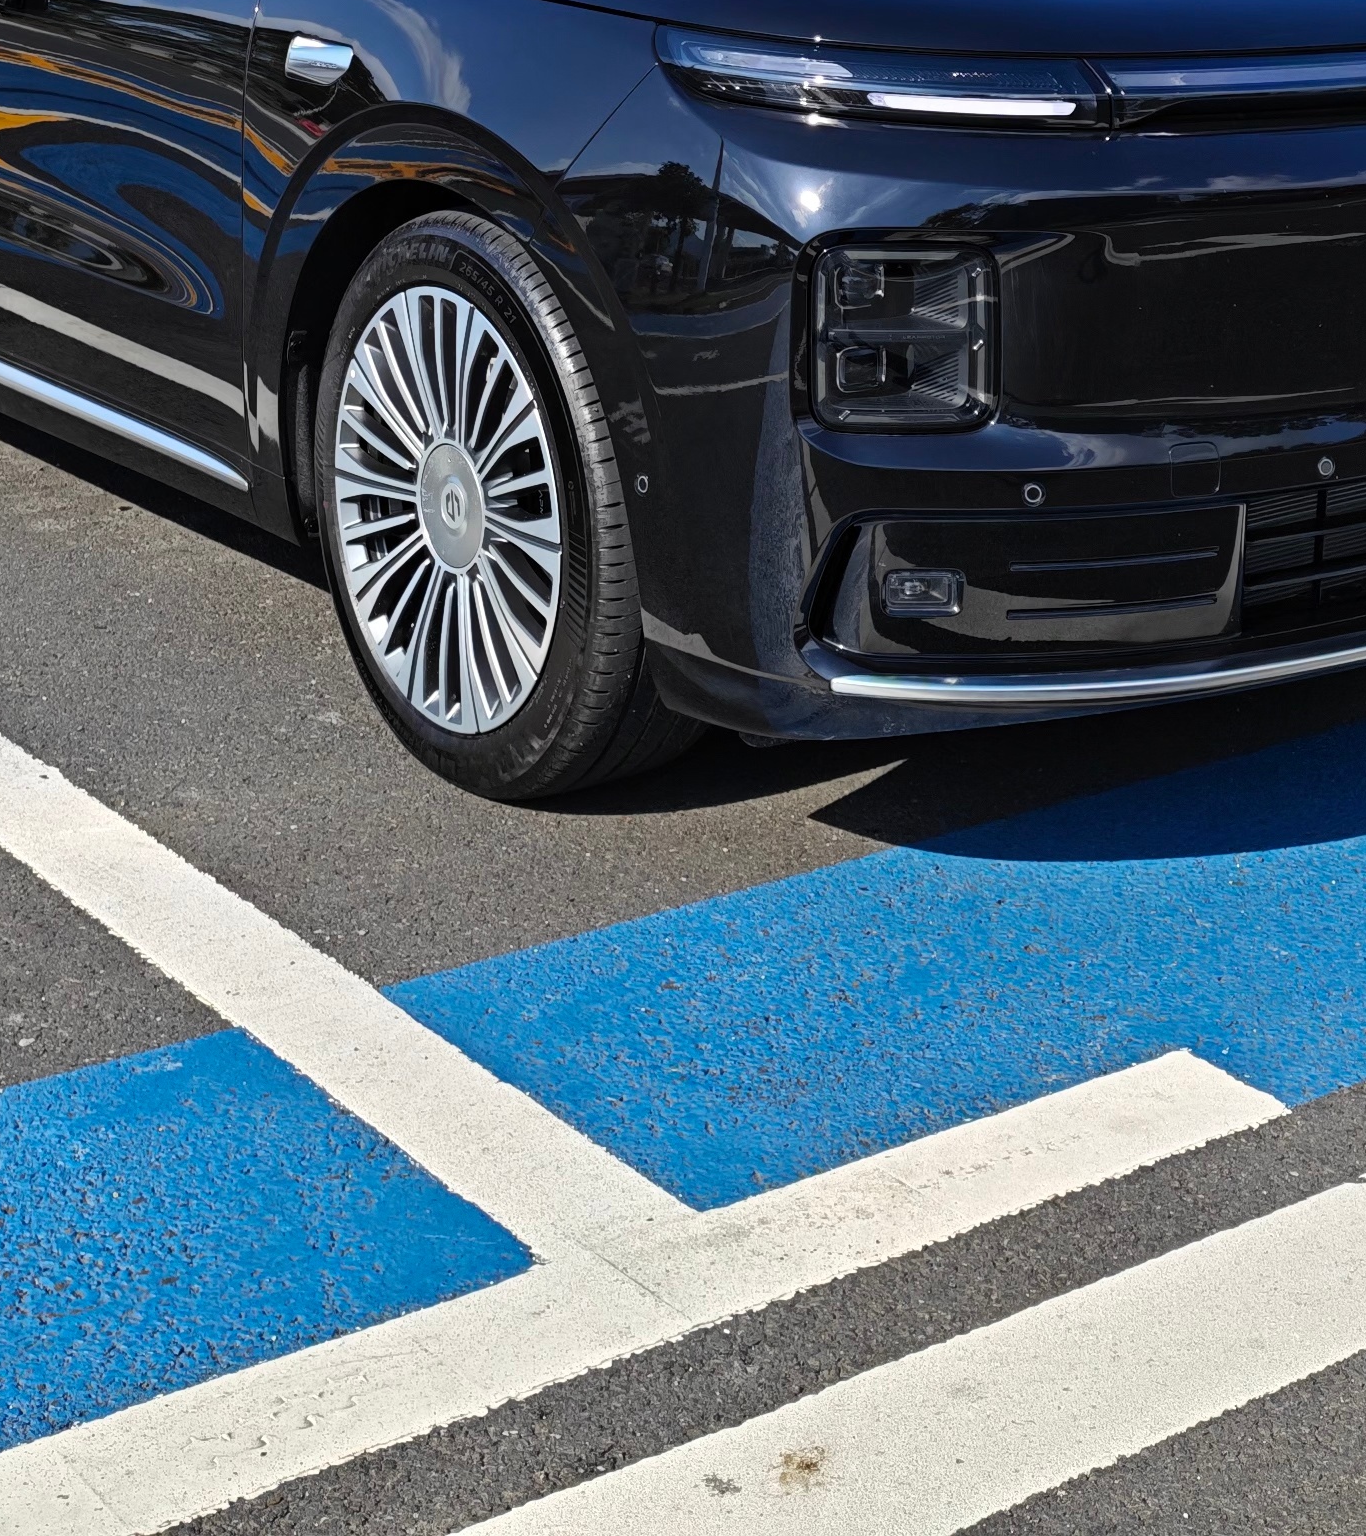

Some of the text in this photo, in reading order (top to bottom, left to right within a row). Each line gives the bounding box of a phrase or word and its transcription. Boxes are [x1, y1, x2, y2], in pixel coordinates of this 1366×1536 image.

[458, 261, 496, 296] 265/45
[494, 295, 504, 307] R
[503, 307, 517, 324] 21
